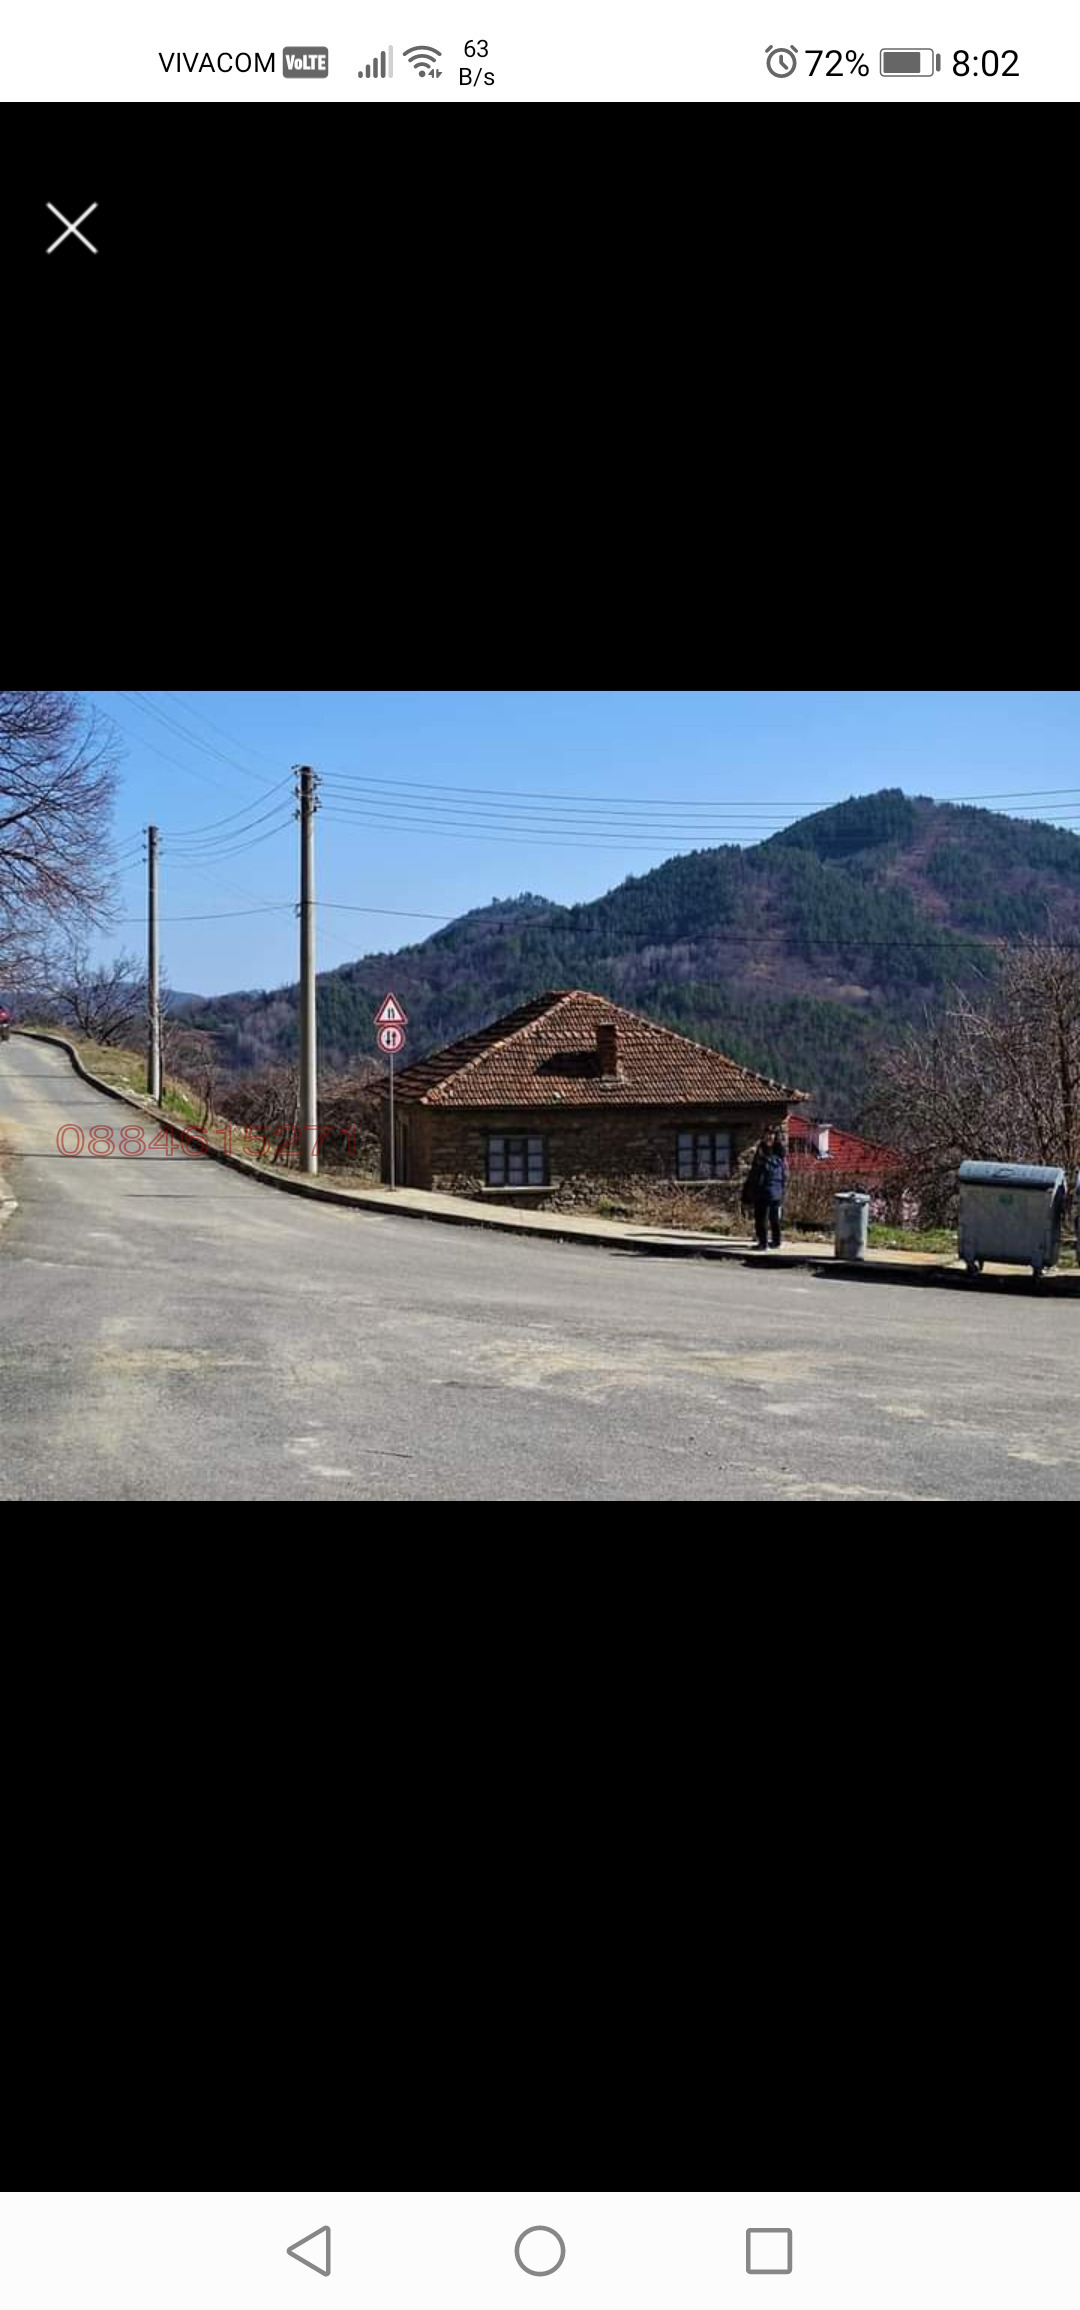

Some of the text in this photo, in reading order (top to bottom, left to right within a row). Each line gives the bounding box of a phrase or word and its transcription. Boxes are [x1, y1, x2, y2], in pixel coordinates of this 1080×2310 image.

[465, 39, 489, 58] 63
[158, 52, 327, 73] VIVACOM VoLTE
[804, 49, 870, 77] 72%
[952, 49, 1020, 77] 8:02
[460, 67, 495, 87] B/s
